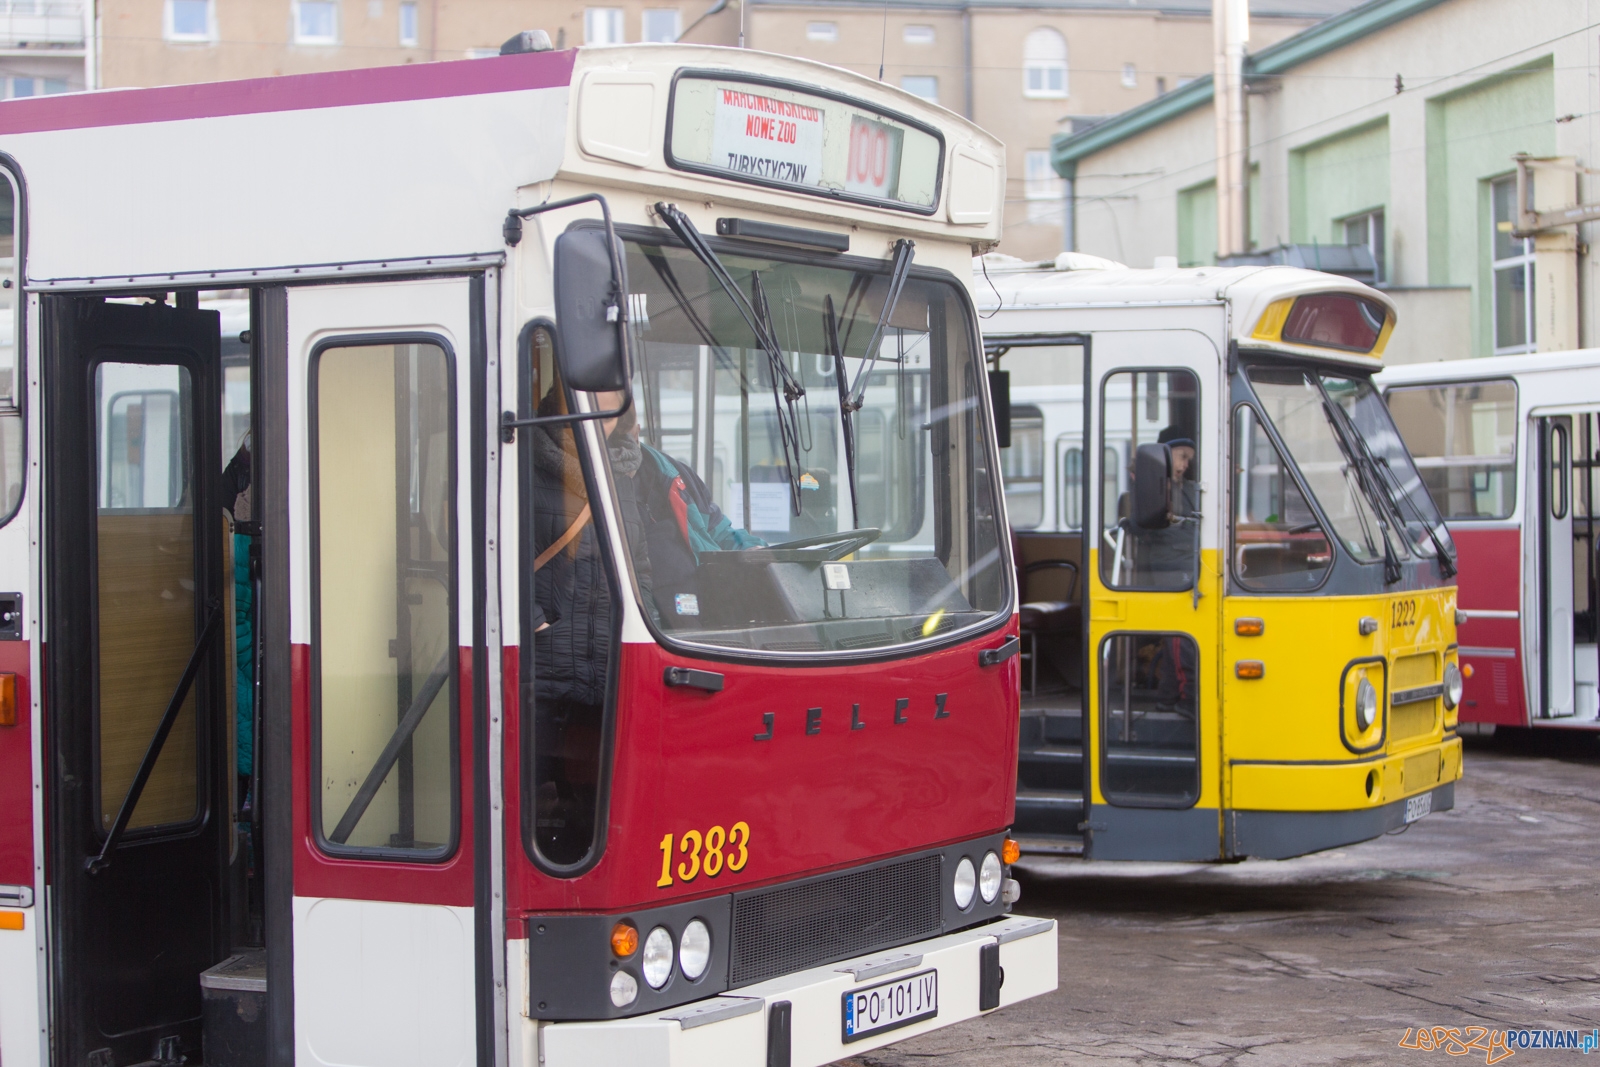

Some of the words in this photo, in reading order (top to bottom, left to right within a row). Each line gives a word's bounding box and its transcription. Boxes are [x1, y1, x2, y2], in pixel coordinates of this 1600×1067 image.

[745, 114, 775, 140] NOWE
[777, 120, 796, 144] ZOO
[728, 152, 807, 183] TURYSTYCZNY
[1391, 599, 1416, 629] 1222
[754, 693, 950, 741] JELCZ
[656, 821, 750, 889] 1383
